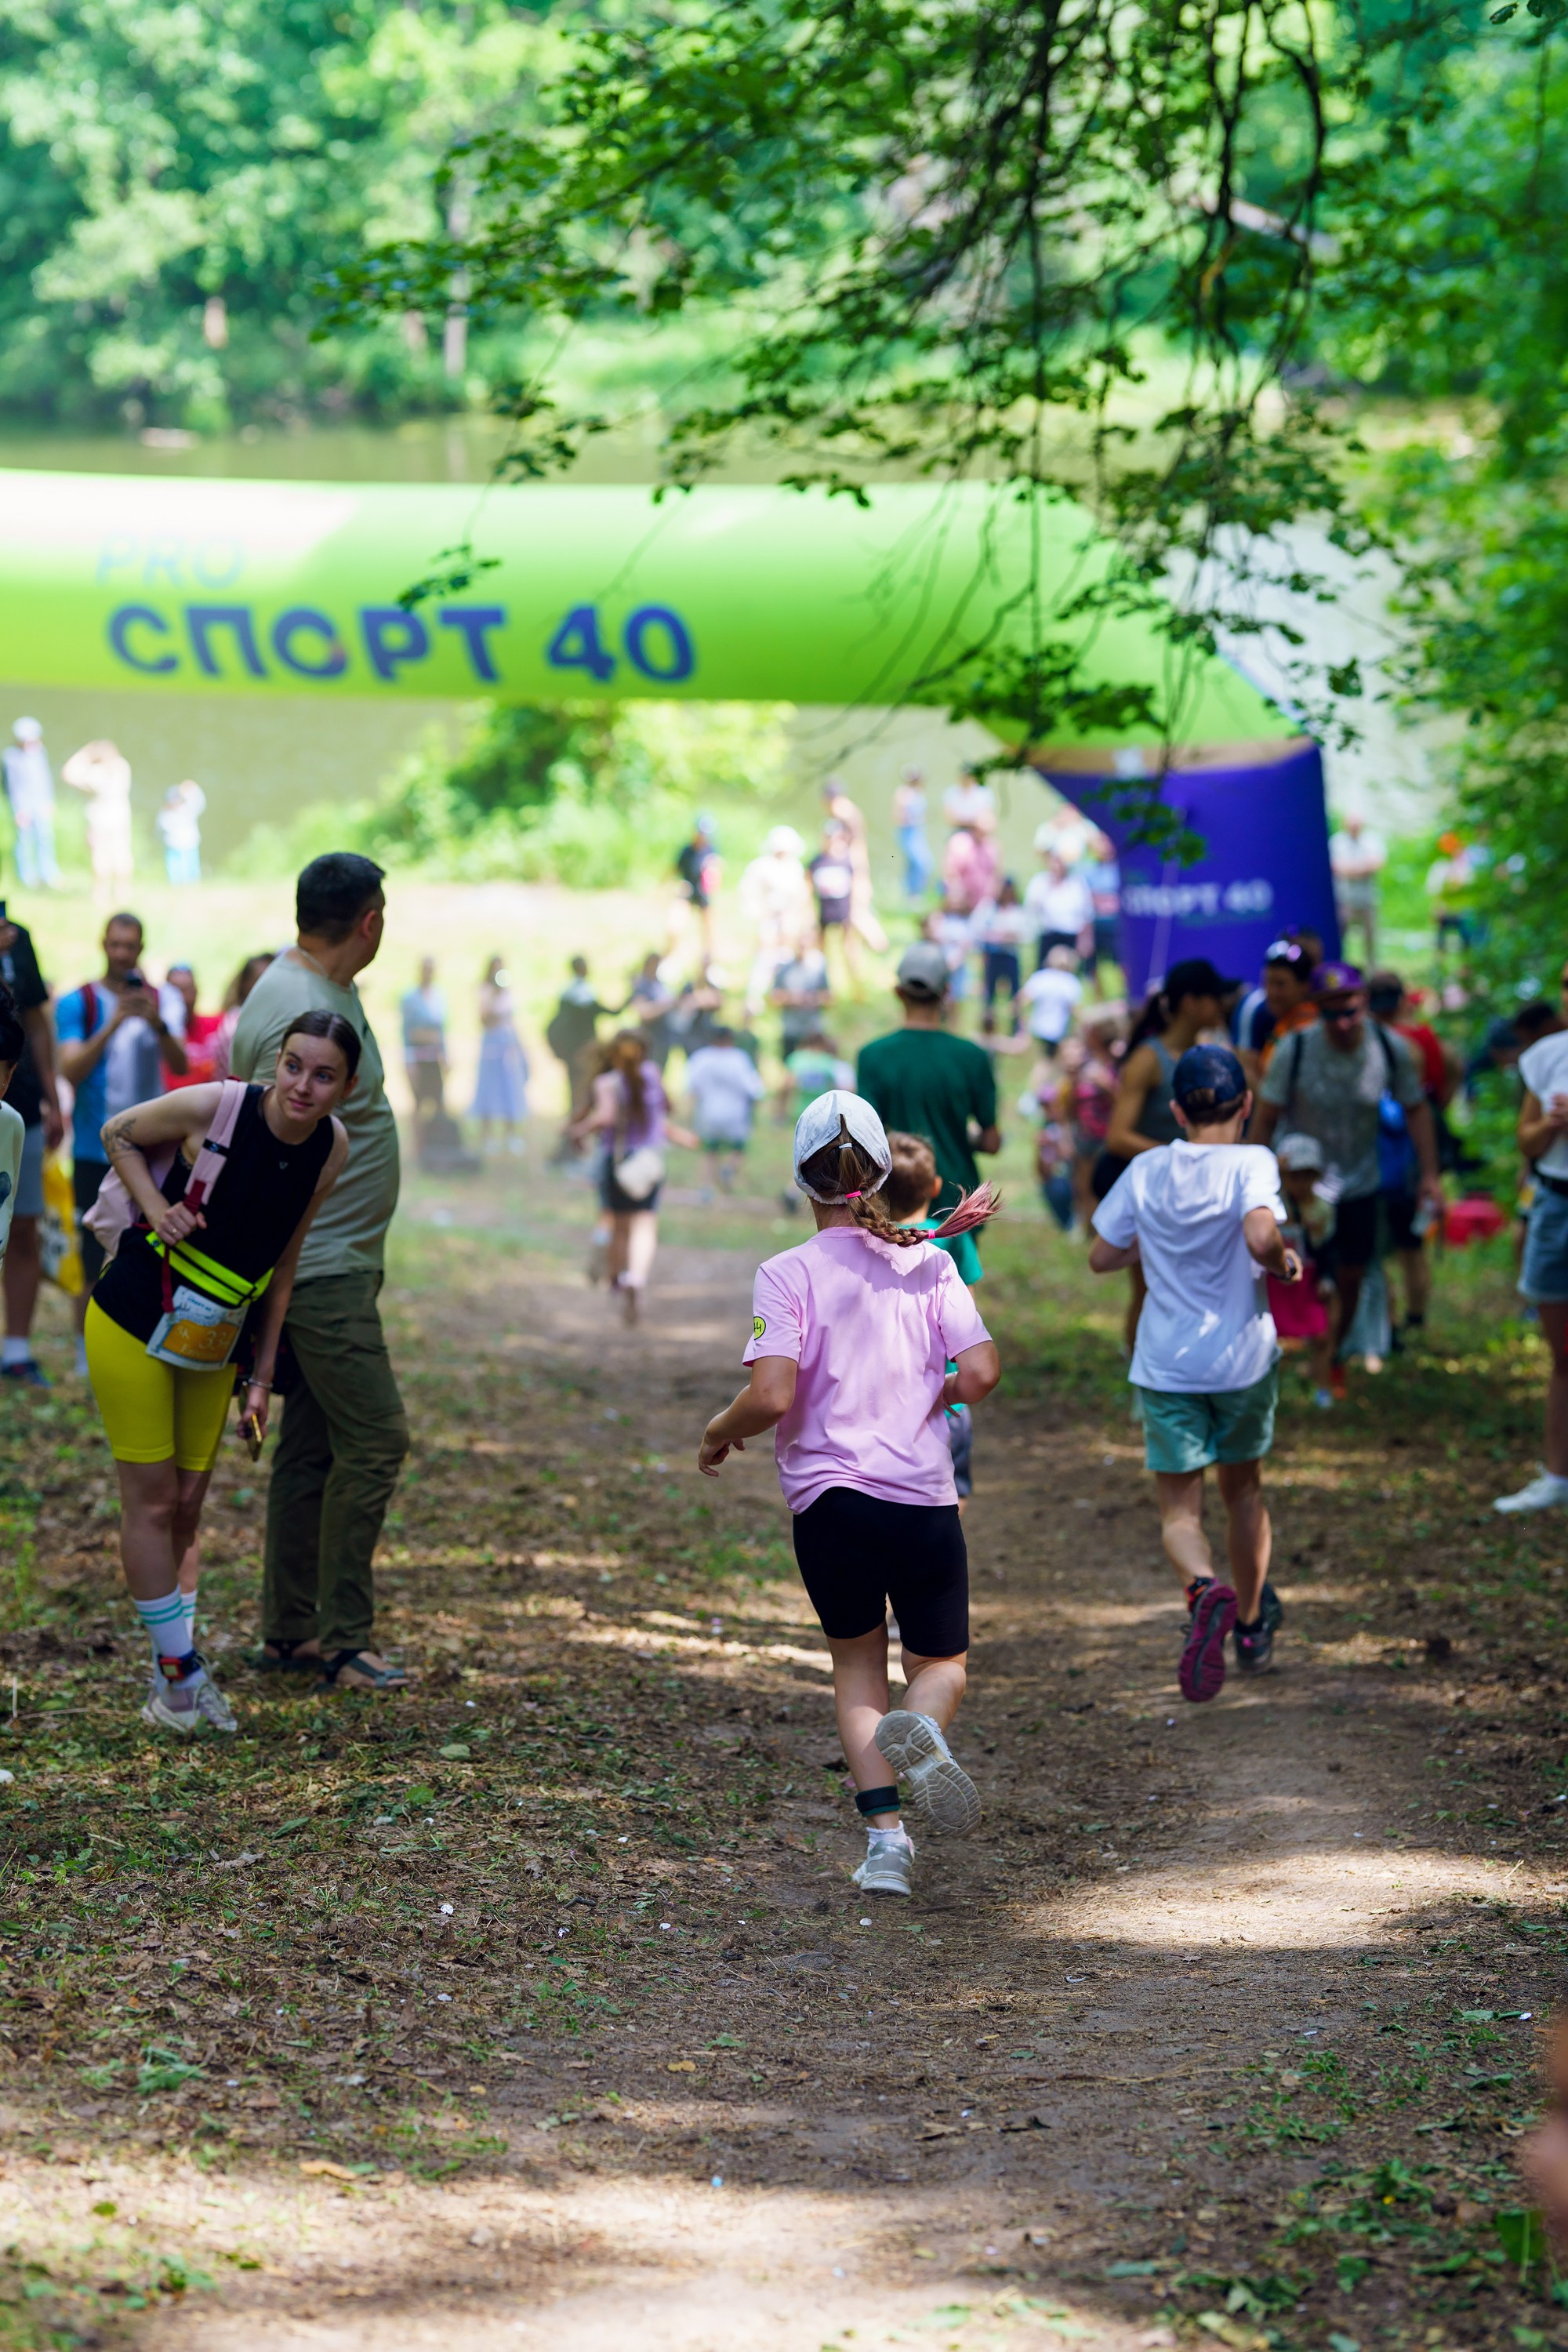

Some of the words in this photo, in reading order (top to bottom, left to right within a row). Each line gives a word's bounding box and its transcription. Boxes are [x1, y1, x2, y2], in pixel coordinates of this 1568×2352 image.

[96, 535, 245, 590] PRO
[107, 603, 507, 684] СПОРТ
[546, 603, 697, 683] 40
